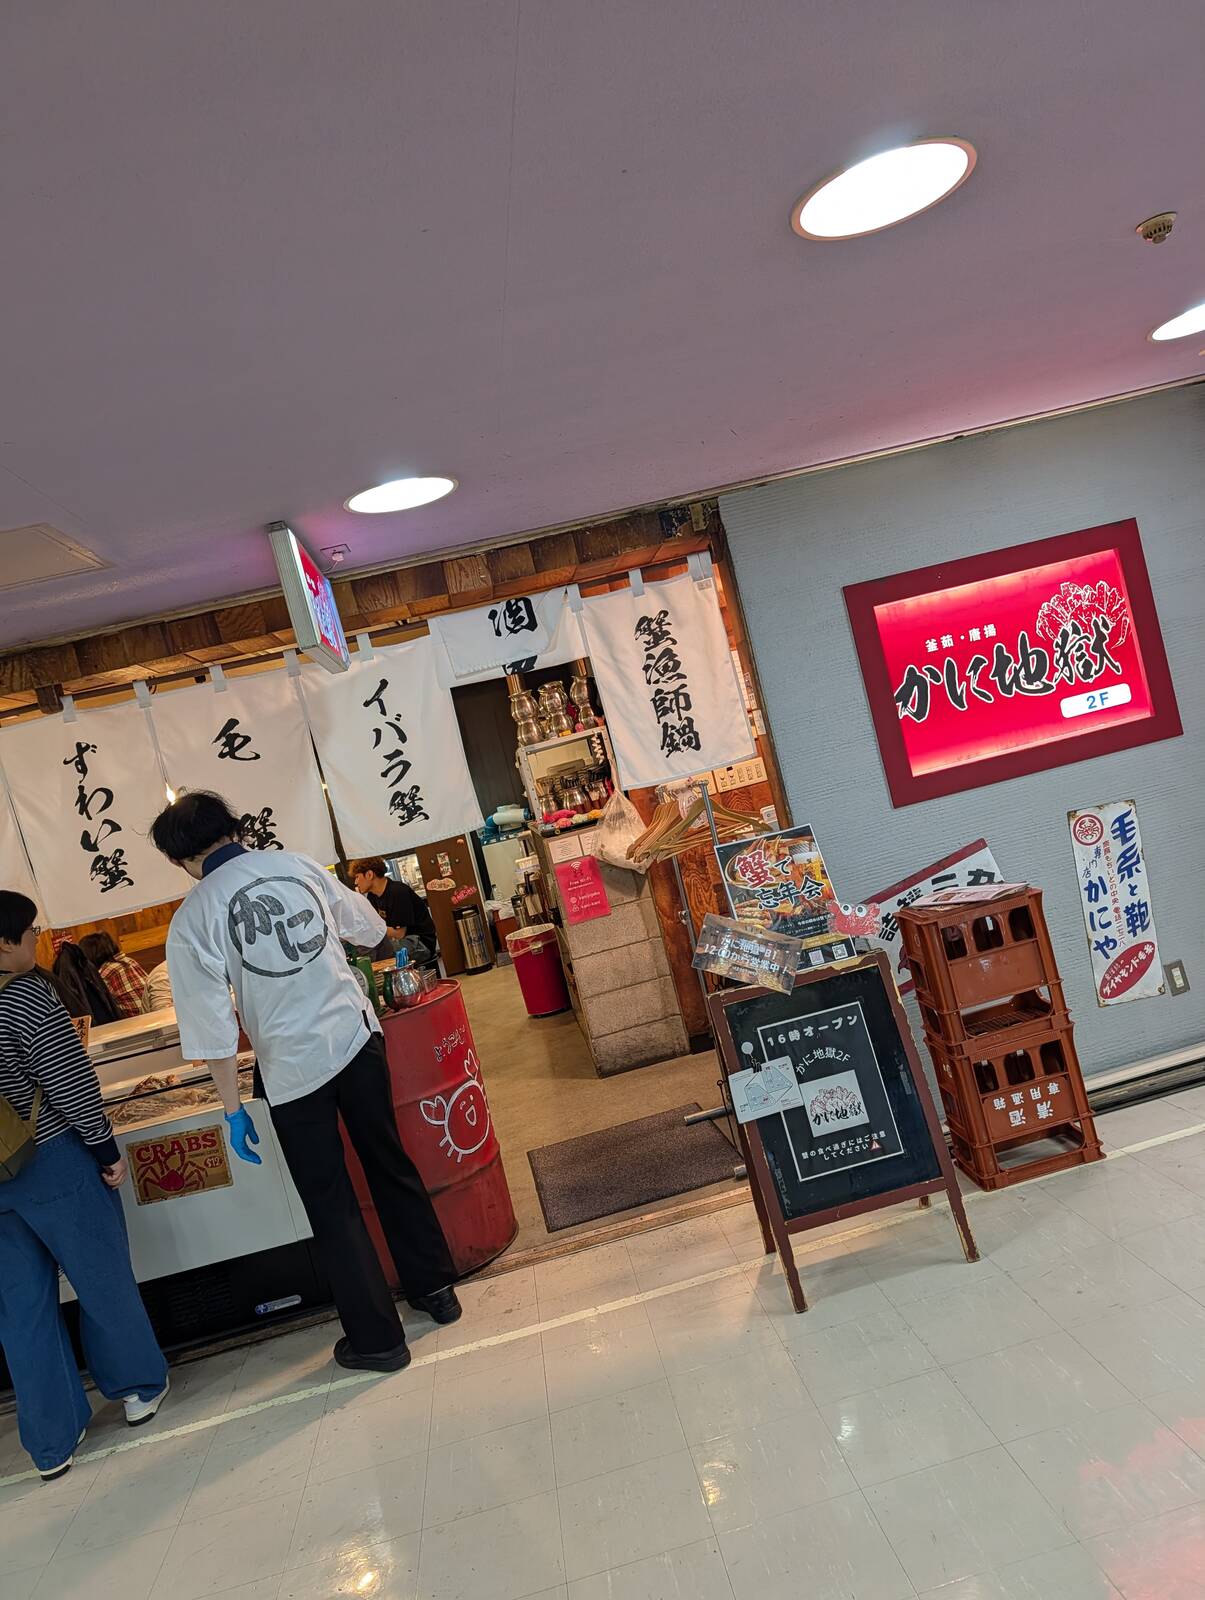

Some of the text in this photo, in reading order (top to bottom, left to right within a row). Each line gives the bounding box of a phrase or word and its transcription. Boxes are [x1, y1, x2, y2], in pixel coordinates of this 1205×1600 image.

[634, 609, 702, 758] 蟹漁師鍋
[894, 615, 1122, 723] かに地獄
[1086, 690, 1110, 711] 2F
[363, 678, 430, 827] イバラ蟹
[63, 741, 134, 893] ずわい蟹
[734, 849, 792, 891] 蟹で
[757, 876, 825, 911] 忘年会
[1110, 808, 1151, 938] 毛糸と鞄
[231, 892, 327, 963] かに
[1083, 876, 1118, 960] かにや
[767, 1014, 858, 1047] 16時オープン
[1009, 1100, 1054, 1128] 清酒
[136, 1131, 218, 1164] CRABS
[823, 1143, 869, 1161] してください
